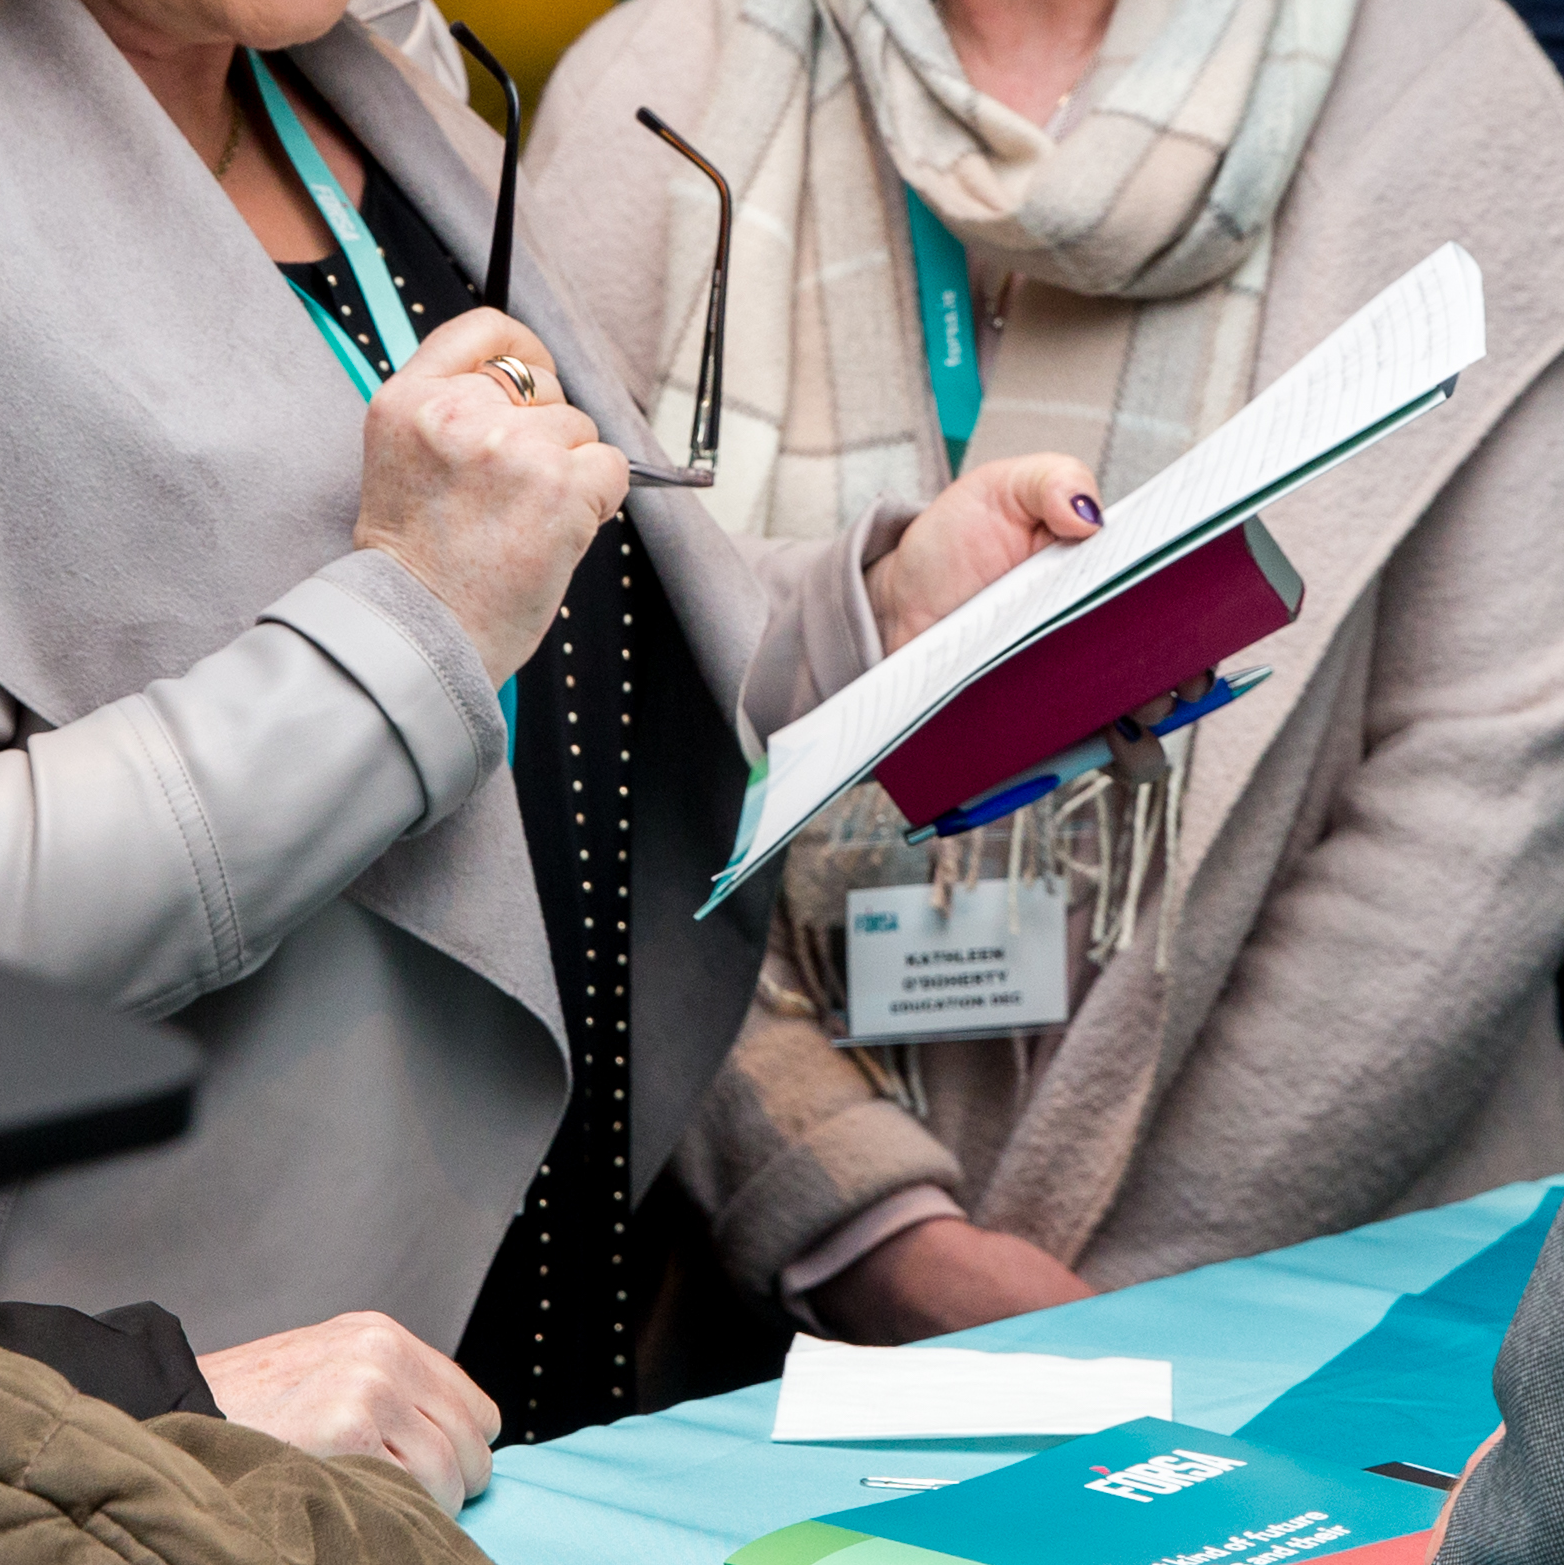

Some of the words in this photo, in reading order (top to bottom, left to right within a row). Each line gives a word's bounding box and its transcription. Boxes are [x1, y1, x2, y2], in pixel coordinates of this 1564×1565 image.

[905, 947, 1005, 967] KATHLEEN
[902, 970, 1008, 992] O'DOHERTY
[889, 997, 984, 1016] EDUCATION
[1223, 1536, 1257, 1551] of
[1243, 1511, 1330, 1543] future
[1246, 1544, 1300, 1565] and
[1285, 1524, 1352, 1550] their
